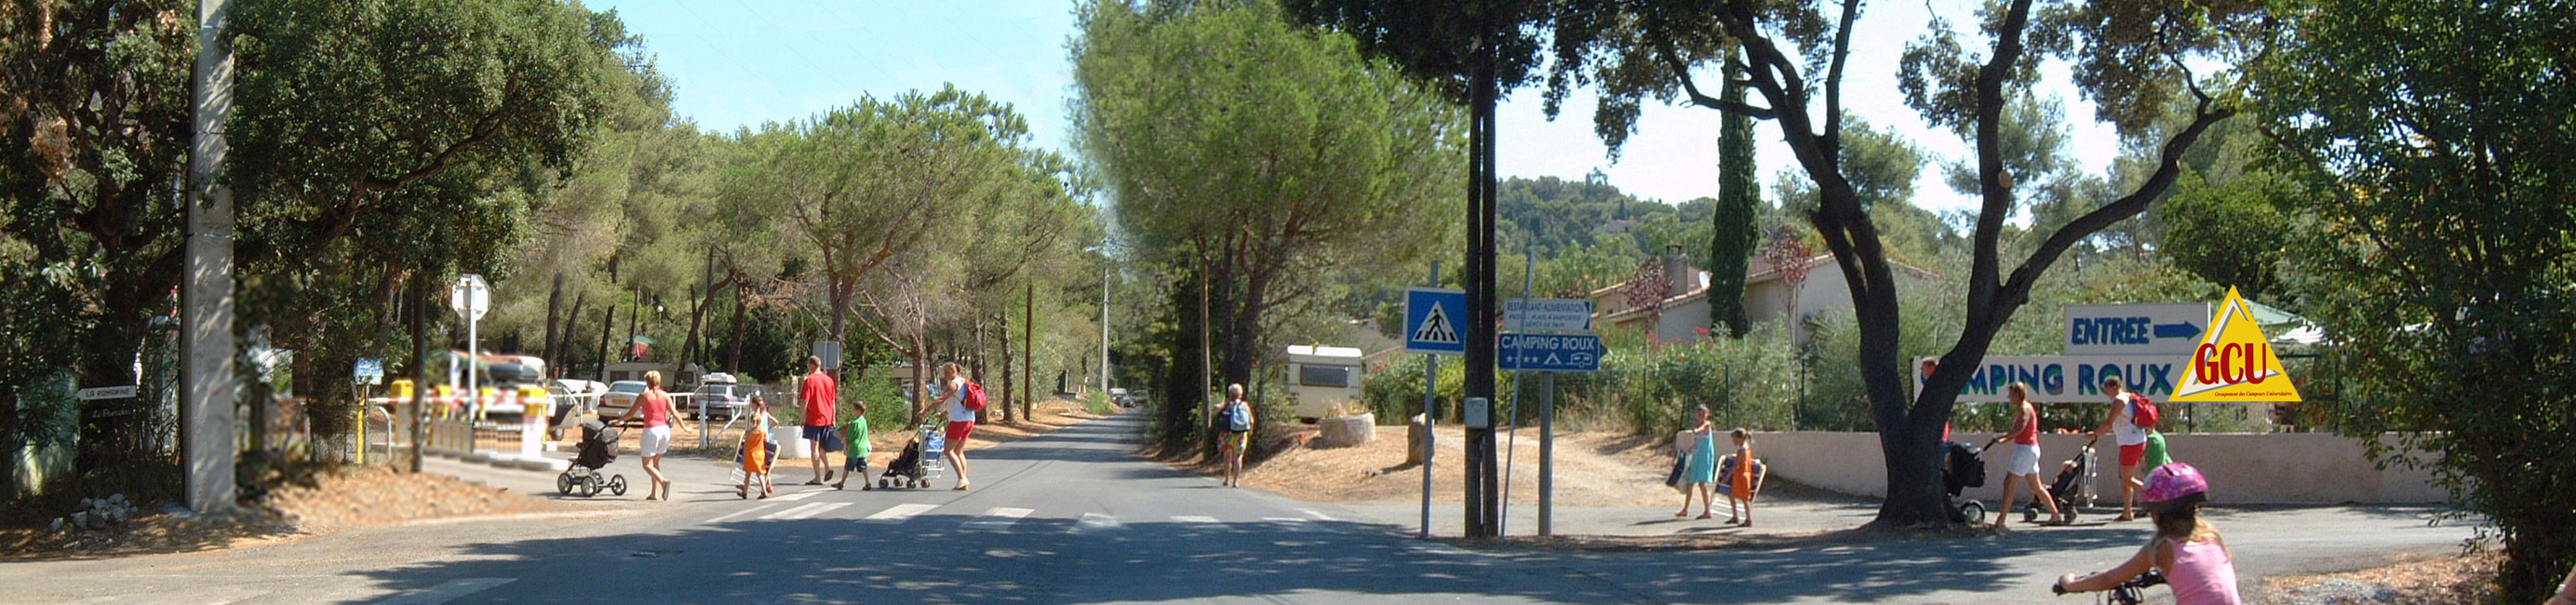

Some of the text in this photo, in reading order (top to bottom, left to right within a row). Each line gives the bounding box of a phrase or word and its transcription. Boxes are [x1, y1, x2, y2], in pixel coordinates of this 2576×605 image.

[1500, 336, 1595, 351] CAMPING ROUX
[2072, 317, 2151, 344] ENTREE
[2078, 363, 2172, 396] ROUX
